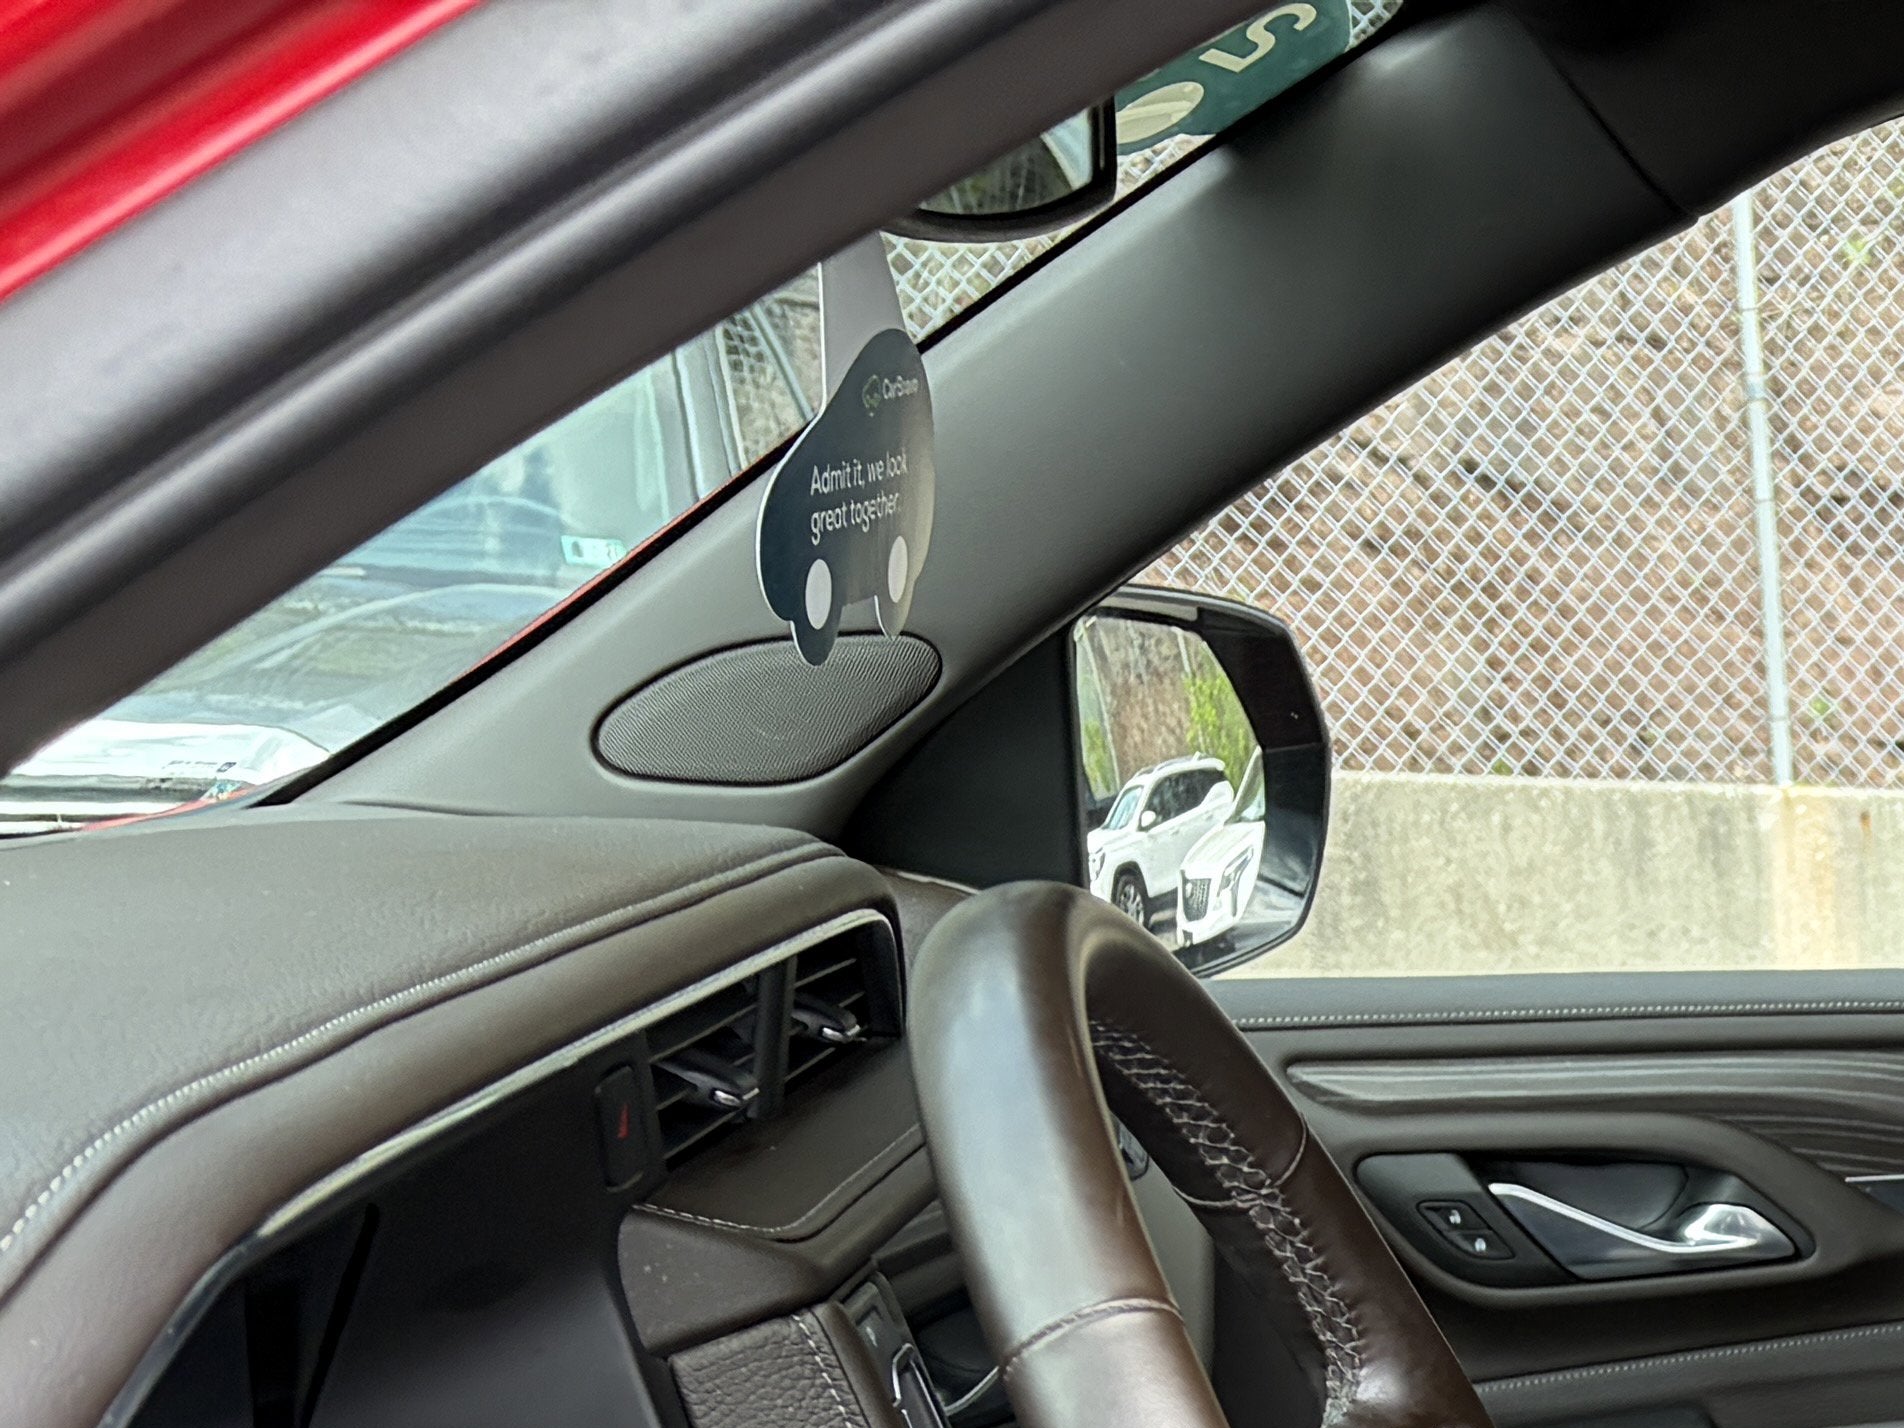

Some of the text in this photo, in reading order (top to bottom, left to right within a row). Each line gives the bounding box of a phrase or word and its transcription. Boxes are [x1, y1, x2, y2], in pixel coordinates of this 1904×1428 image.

[811, 458, 852, 496] Admit
[853, 458, 865, 489] it,
[867, 459, 885, 482] we
[811, 502, 848, 546] great
